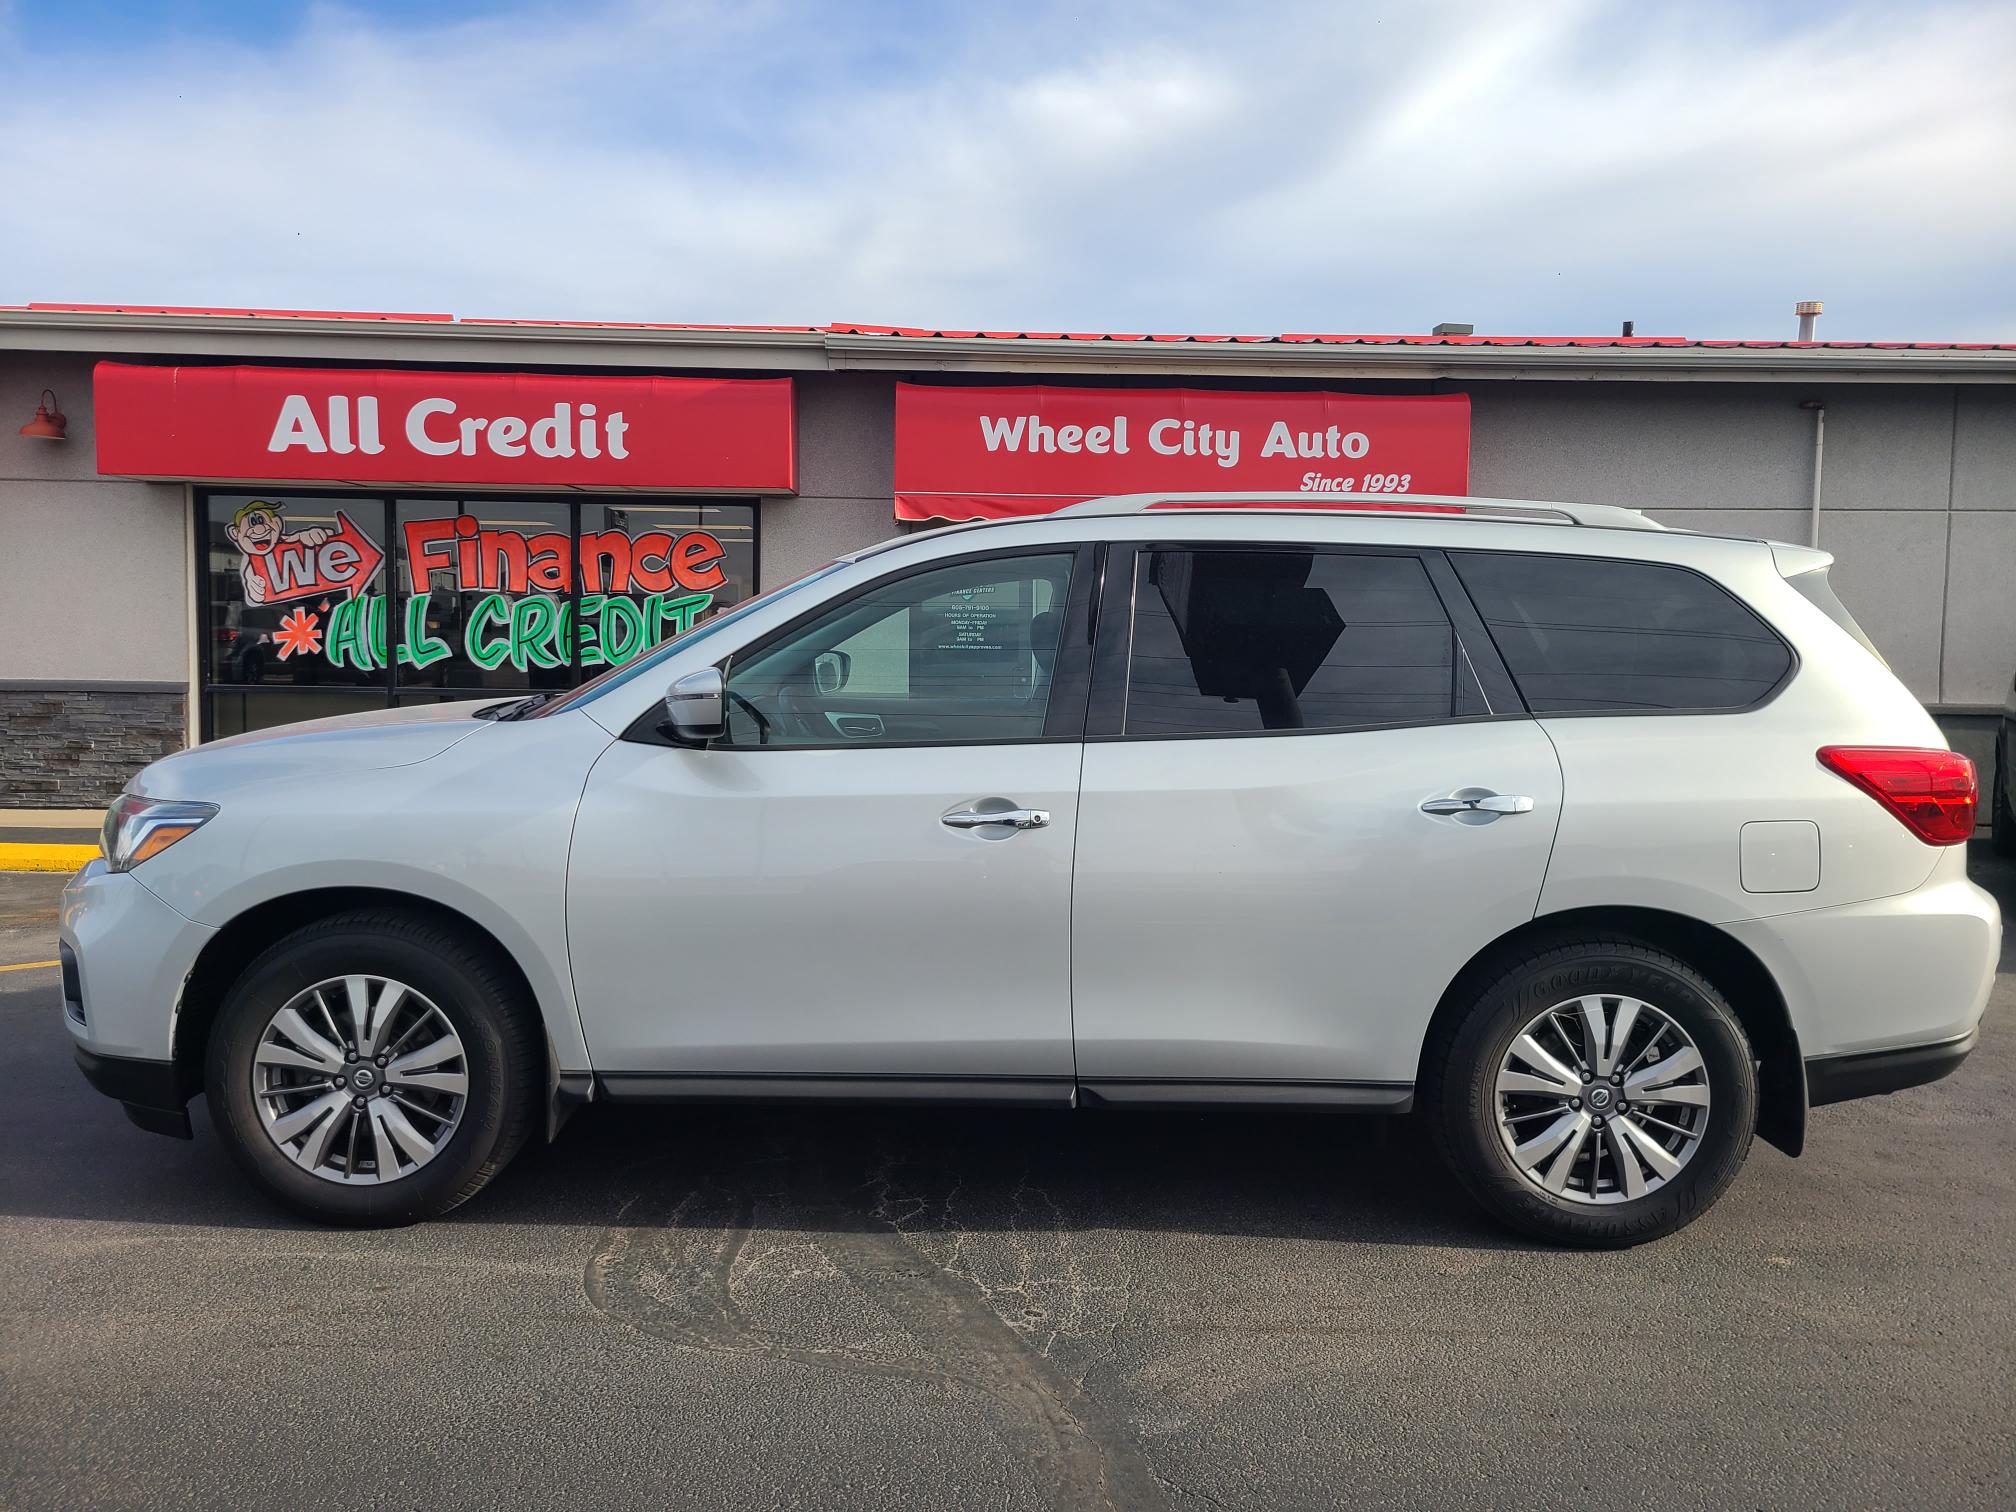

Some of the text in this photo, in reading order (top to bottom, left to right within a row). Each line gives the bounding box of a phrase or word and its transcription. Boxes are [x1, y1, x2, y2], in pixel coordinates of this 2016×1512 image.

[267, 394, 630, 460] All Credit
[979, 415, 1370, 468] Wheel City Auto
[1300, 472, 1411, 493] Since 1993
[403, 514, 729, 596] Finance
[326, 592, 714, 672] ALL CREDIT
